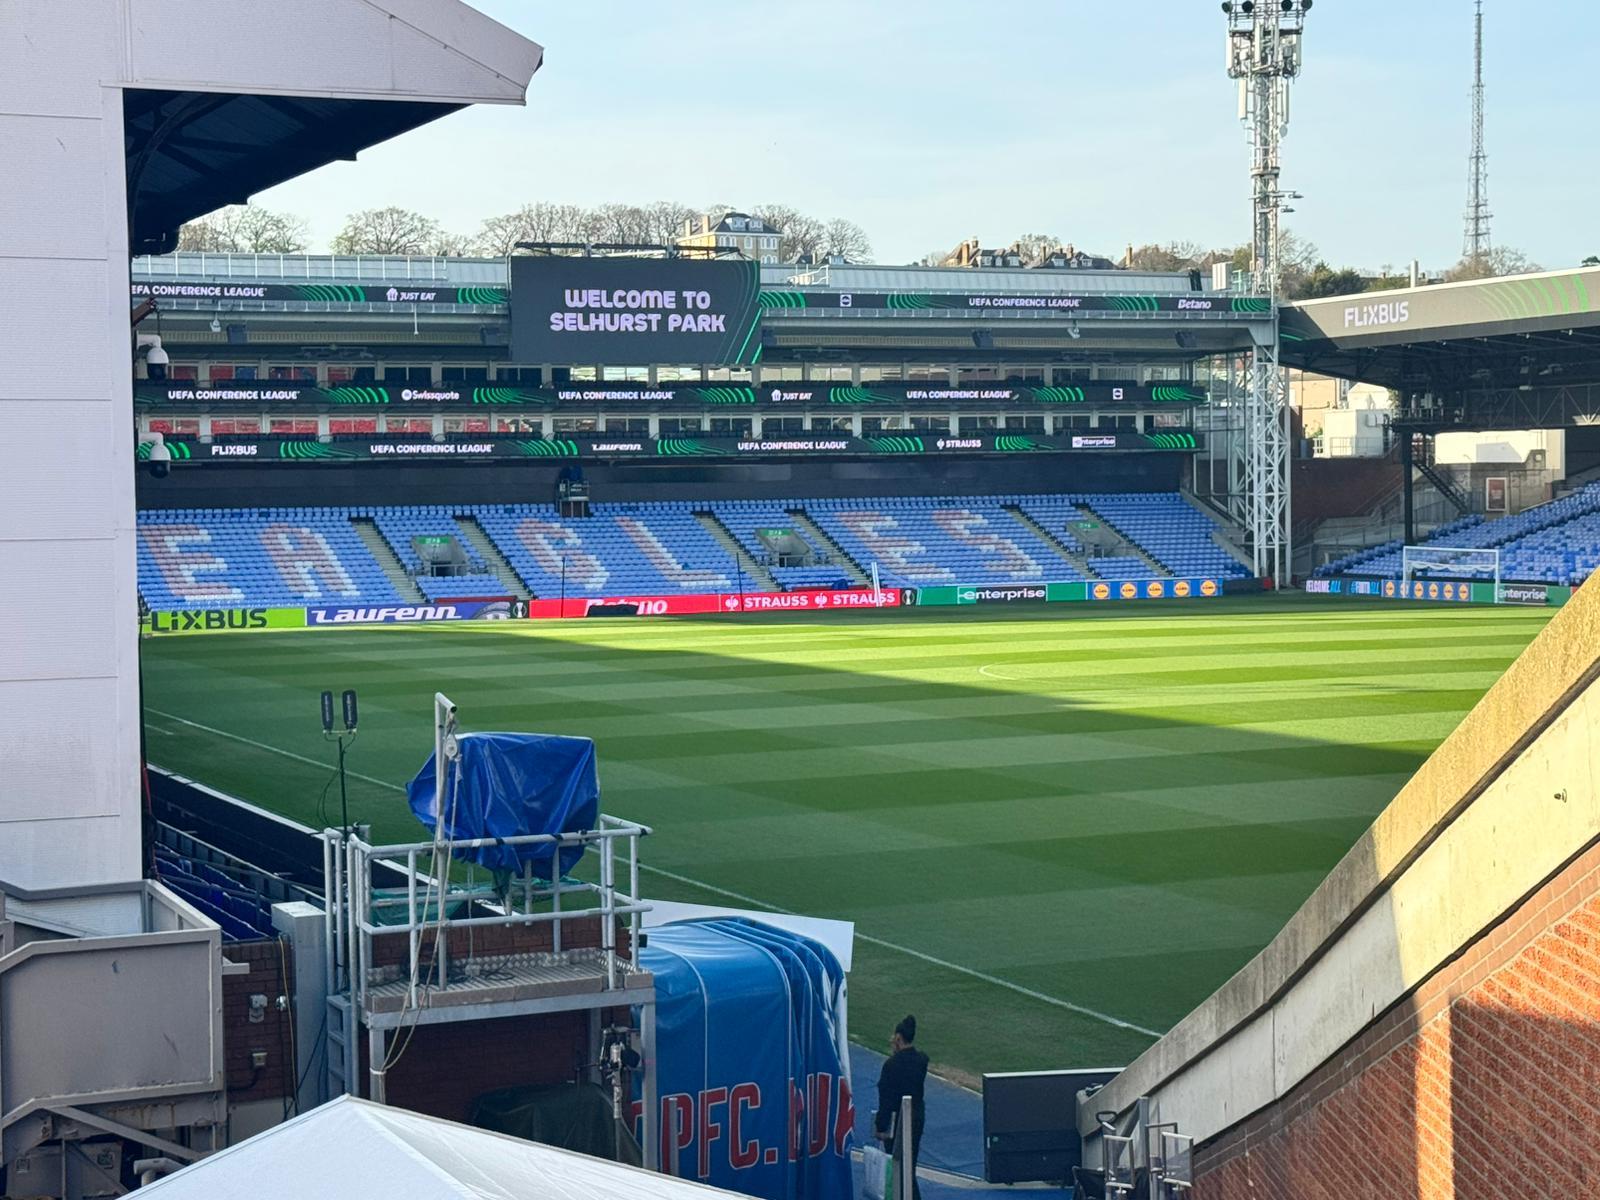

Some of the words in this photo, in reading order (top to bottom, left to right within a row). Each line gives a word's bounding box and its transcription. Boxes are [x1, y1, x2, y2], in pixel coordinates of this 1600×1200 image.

[152, 285, 221, 296] CONFERENCE
[224, 287, 265, 297] LEAGUE
[400, 292, 419, 301] JUST
[420, 292, 436, 301] EAT
[565, 290, 676, 310] WELCOME
[683, 289, 710, 309] TO
[969, 298, 991, 307] UEFA
[992, 298, 1046, 307] CONFERENCE
[1048, 298, 1080, 307] LEAGUE
[1178, 299, 1212, 309] Betano
[550, 313, 661, 332] SELHURST
[669, 313, 725, 332] PARK
[168, 391, 194, 400] UEFA
[195, 391, 259, 400] CONFERENCE
[261, 391, 298, 400] LEAGUE
[412, 390, 460, 402] Swissquote
[559, 391, 582, 400] UEFA
[583, 391, 639, 400] CONFERENCE
[641, 391, 673, 400] LEAGUE
[782, 392, 798, 401] JUST
[799, 392, 812, 401] EAT
[907, 391, 928, 400] UEFA
[929, 391, 979, 400] CONFERENCE
[981, 391, 1013, 400] LEAGUE
[738, 441, 760, 451] UEFA
[760, 441, 814, 451] CONFERENCE
[816, 441, 847, 451] LEAGUE
[945, 439, 982, 448] STRAUSS
[370, 444, 396, 454] UEFA
[396, 444, 456, 454] CONFERENCE
[457, 444, 495, 454] LEAGUE
[963, 588, 1045, 601] enterprise
[1498, 588, 1546, 601] enterprise
[744, 595, 808, 608] STRAUSS
